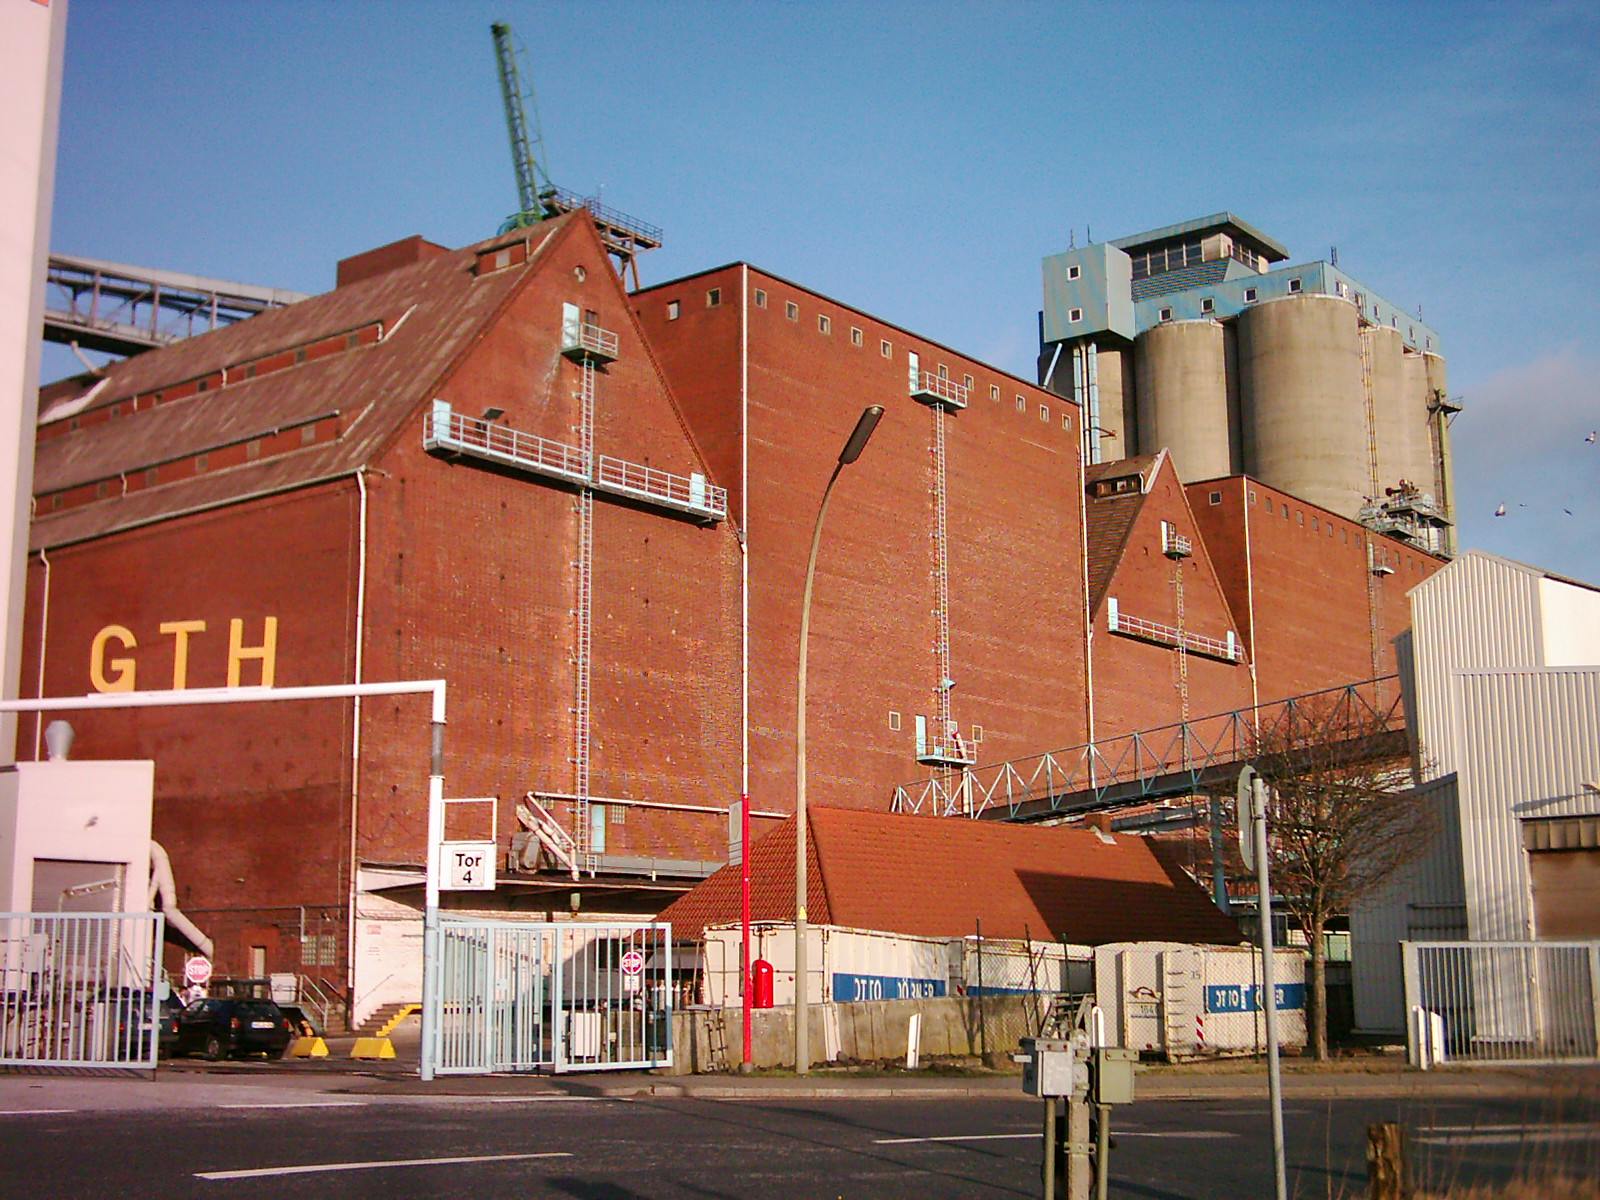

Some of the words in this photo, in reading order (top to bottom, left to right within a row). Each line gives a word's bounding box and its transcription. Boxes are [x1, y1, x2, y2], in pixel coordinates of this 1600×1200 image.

[90, 616, 278, 692] GTH
[455, 853, 482, 867] Tor
[462, 870, 473, 883] 4
[188, 964, 210, 975] STOP
[622, 958, 642, 968] STOP
